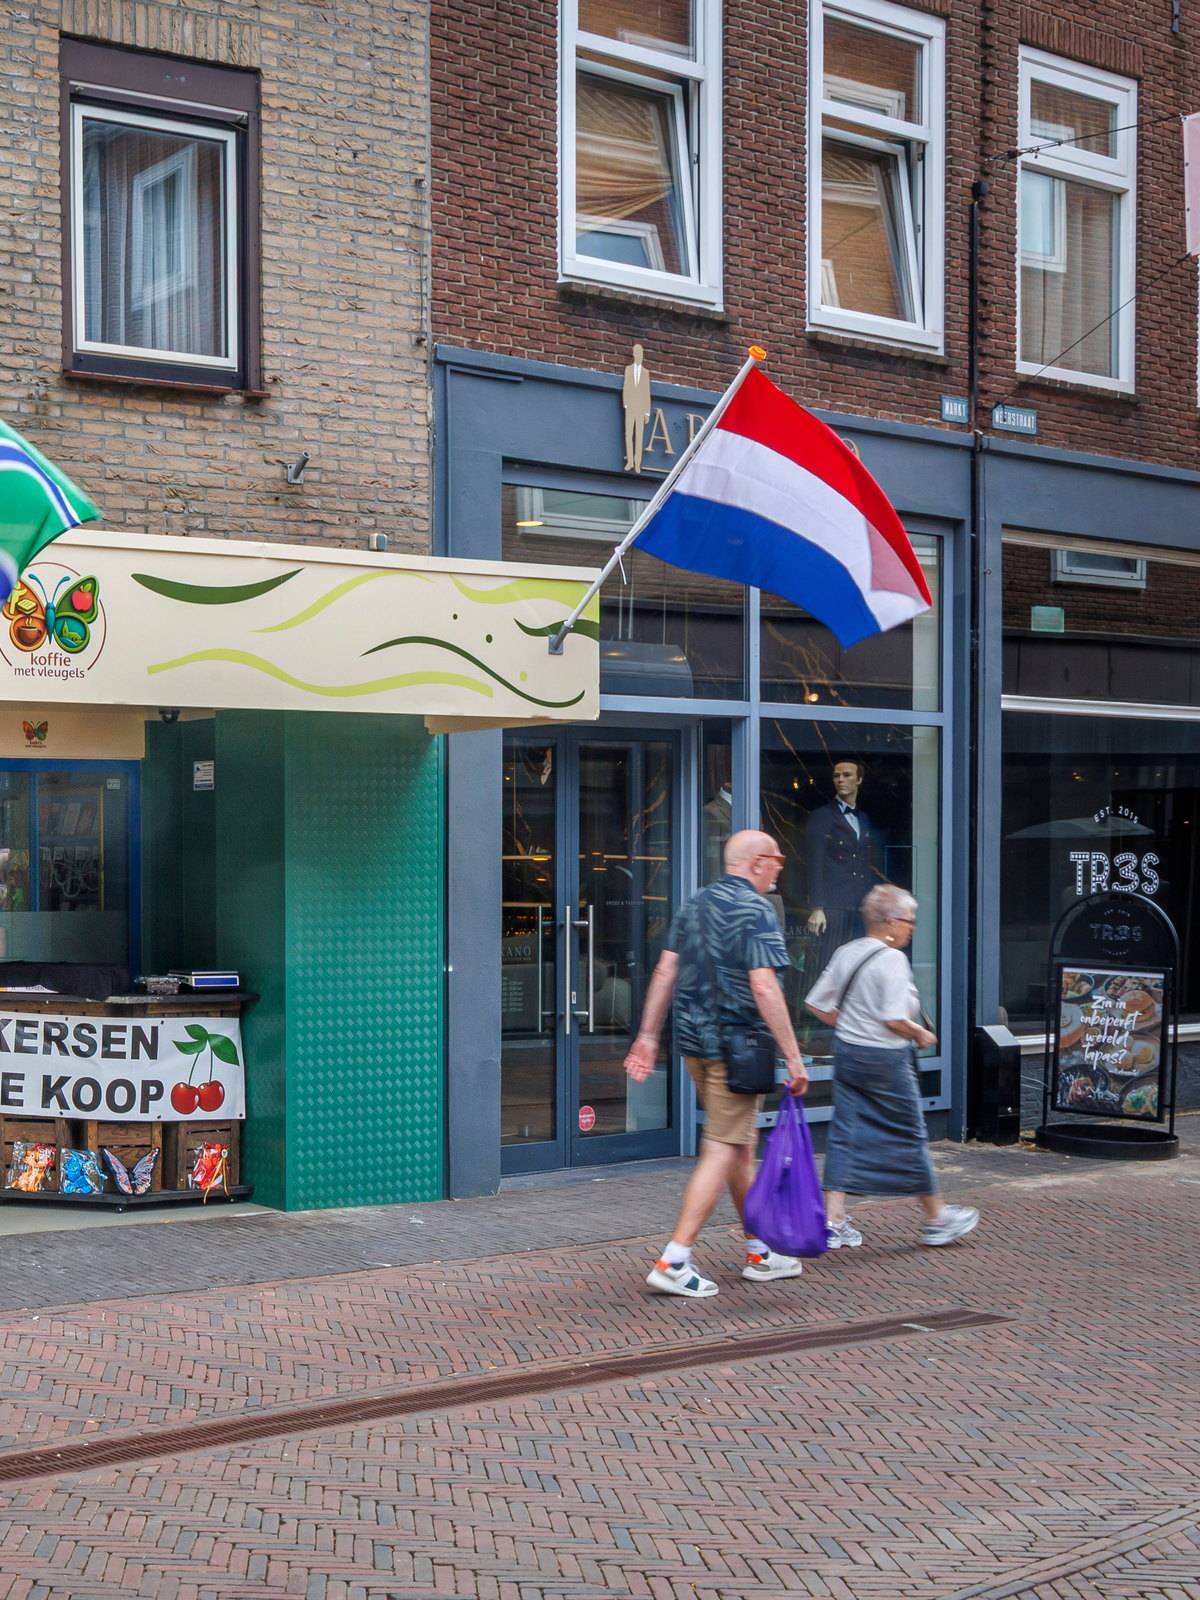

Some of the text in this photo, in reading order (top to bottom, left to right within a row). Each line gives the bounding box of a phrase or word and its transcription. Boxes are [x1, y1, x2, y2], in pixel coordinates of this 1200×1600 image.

[30, 652, 71, 667] koffie
[14, 666, 85, 680] met vleugels
[1093, 806, 1139, 824] EST. 2015
[1069, 851, 1160, 895] TR3S
[1091, 995, 1127, 1010] Zin in
[1086, 1030, 1129, 1048] wereld
[41, 1074, 164, 1114] KOOP
